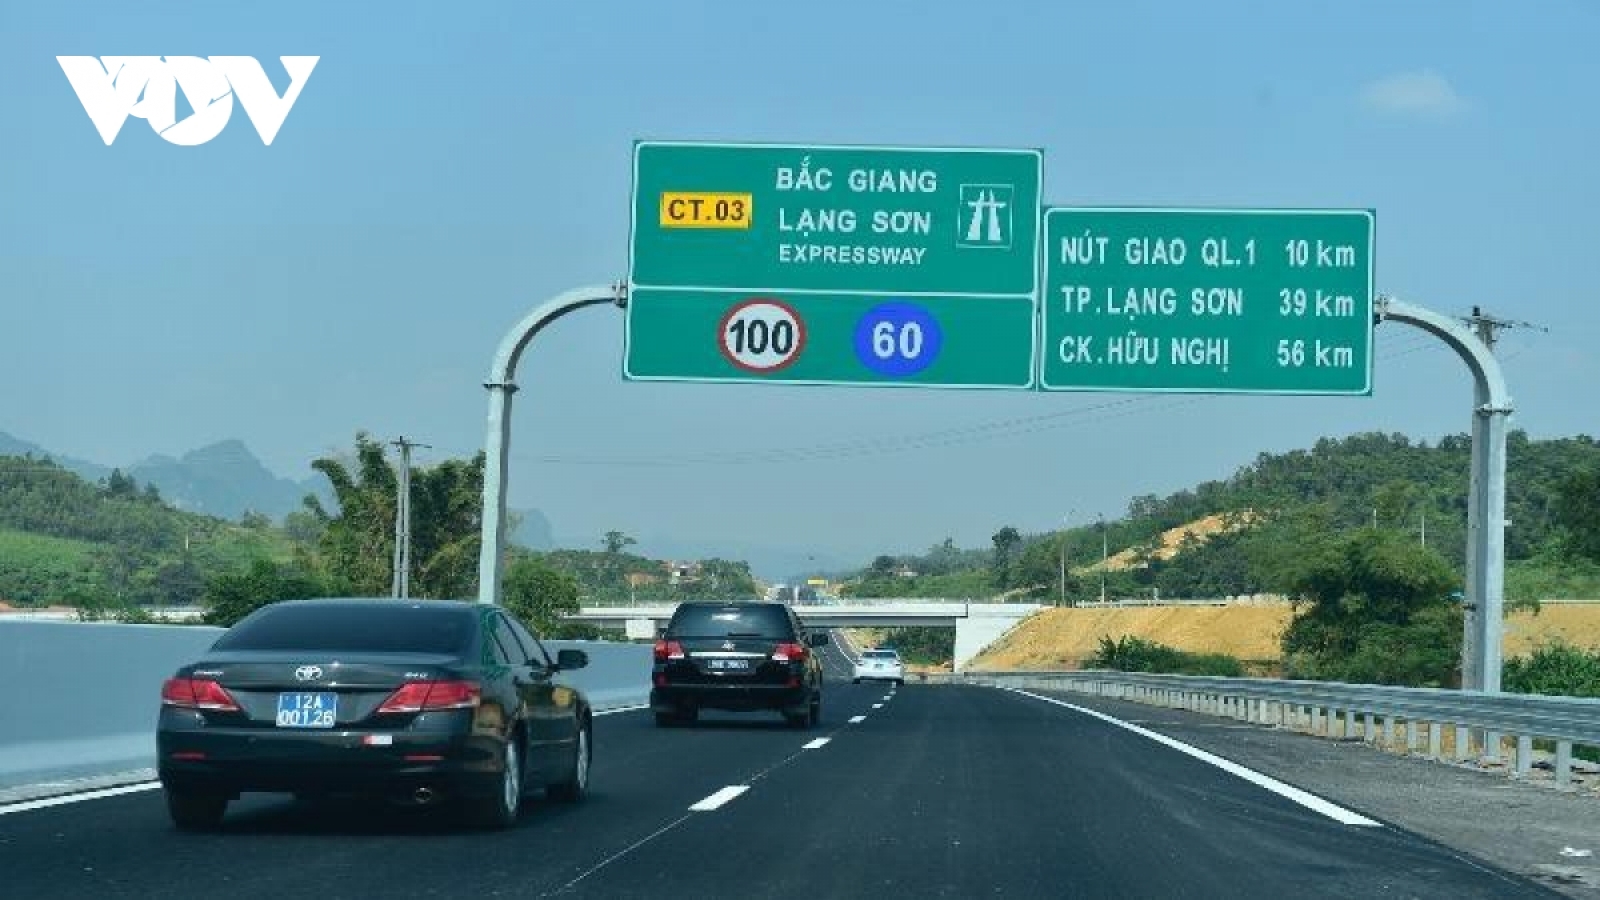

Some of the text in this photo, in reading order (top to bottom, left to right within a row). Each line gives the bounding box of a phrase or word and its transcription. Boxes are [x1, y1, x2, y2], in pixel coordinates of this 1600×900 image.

[776, 156, 937, 192] BẮC GIANG
[668, 199, 744, 220] CT.03
[779, 208, 931, 236] LẠNG SƠN
[779, 244, 927, 265] EXPRESSWAY
[1061, 229, 1355, 268] NÚT GIAO QL.1 10 km
[1061, 286, 1355, 320] TP.LẠNG SƠN 39 km
[728, 319, 794, 356] 100
[872, 321, 923, 359] 60
[1171, 338, 1230, 372] NGHỊ
[1276, 340, 1305, 367] 56
[1315, 340, 1353, 368] km
[295, 695, 321, 709] 12A
